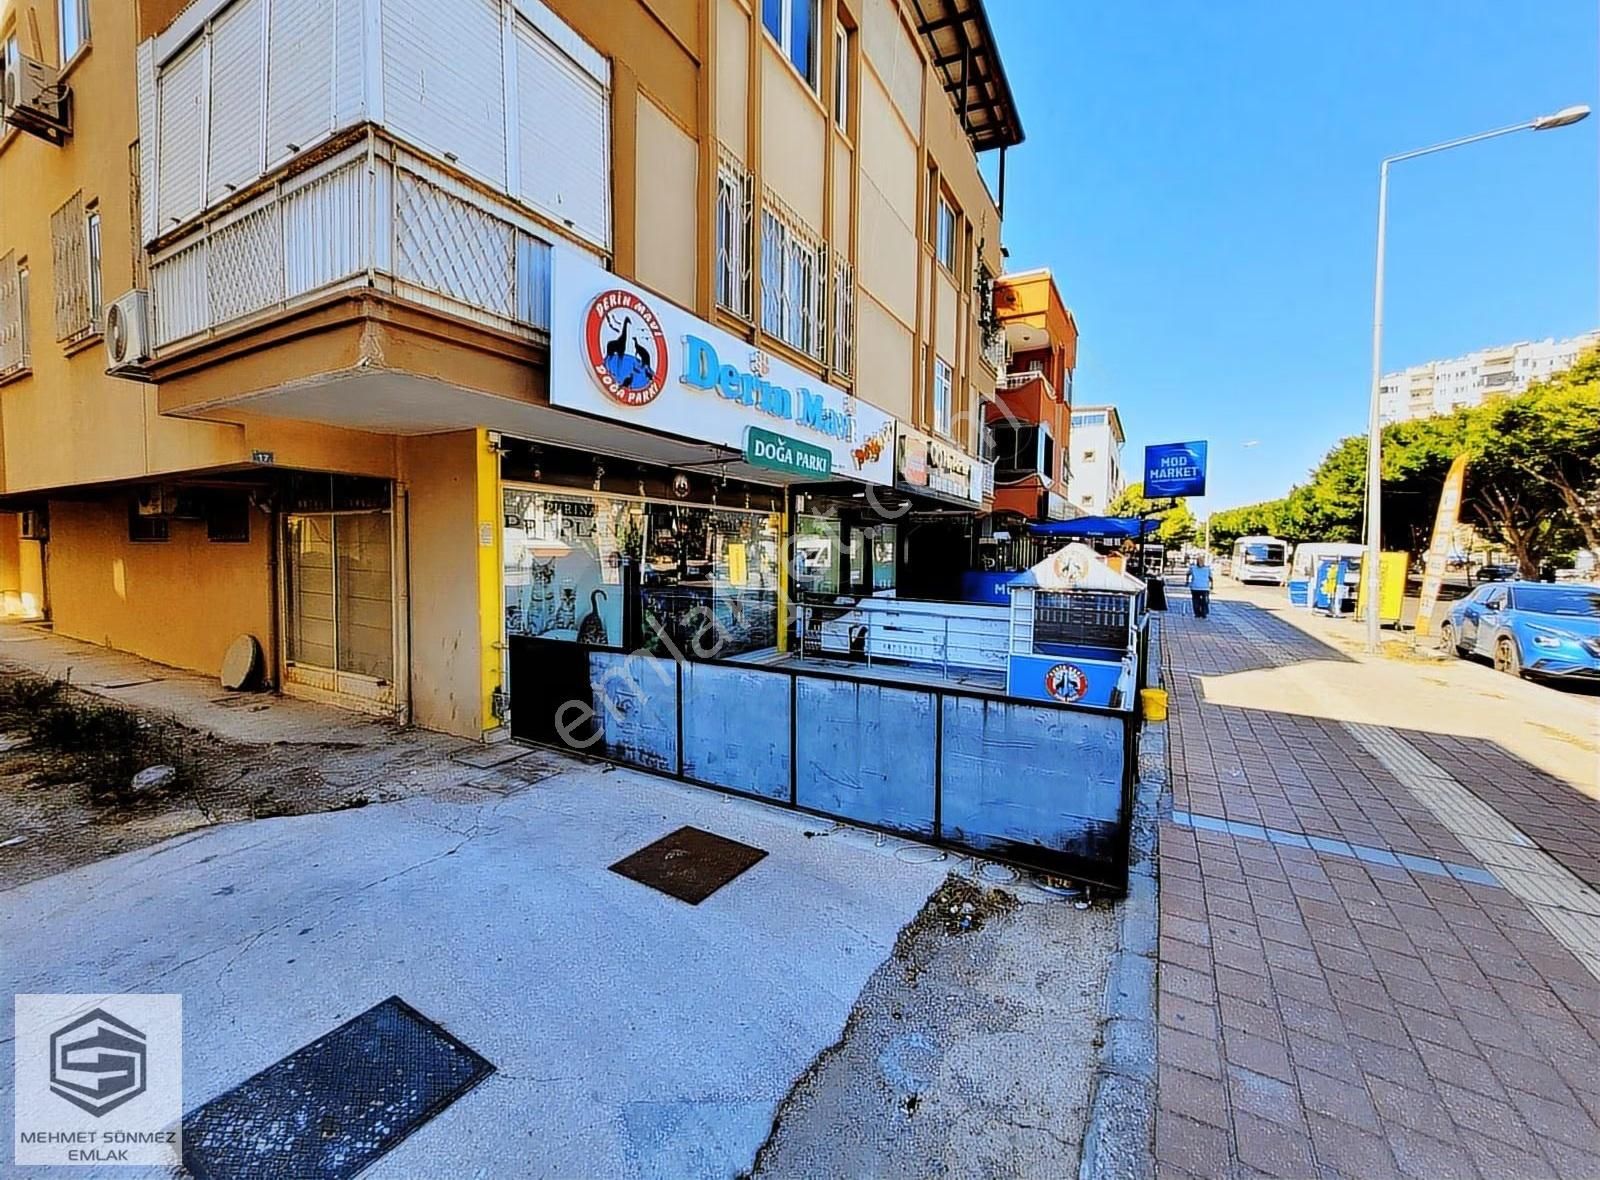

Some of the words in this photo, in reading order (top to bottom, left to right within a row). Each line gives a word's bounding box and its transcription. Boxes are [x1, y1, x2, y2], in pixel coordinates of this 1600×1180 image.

[679, 334, 792, 420] Derin
[796, 386, 857, 443] Mavi
[754, 436, 793, 465] DOĞA
[796, 451, 828, 473] PARKI
[1161, 456, 1188, 468] MOD
[1149, 466, 1199, 480] MARKET
